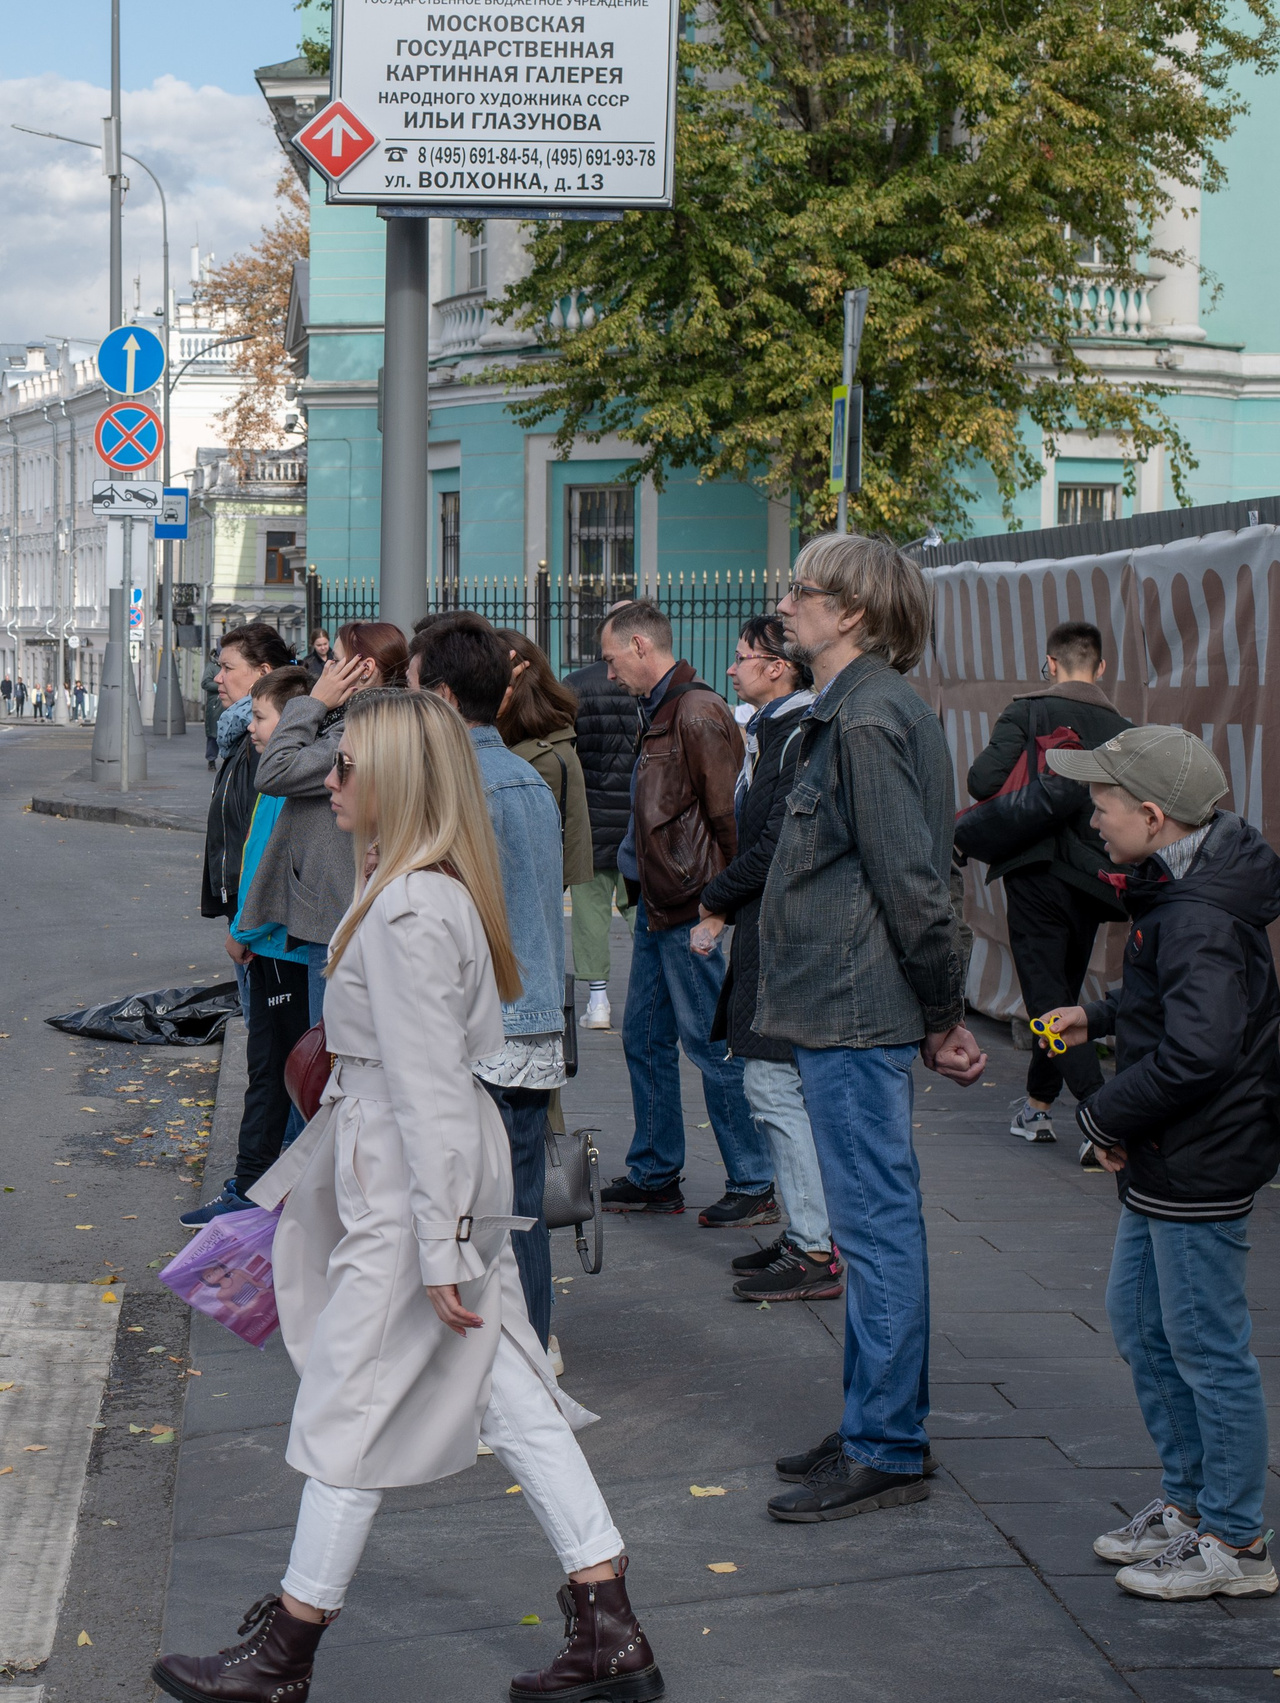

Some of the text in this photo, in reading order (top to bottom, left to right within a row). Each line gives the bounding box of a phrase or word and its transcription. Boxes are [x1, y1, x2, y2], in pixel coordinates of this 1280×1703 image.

[427, 14, 585, 33] МОСКОВСКАЯ
[396, 39, 614, 60] ГОСУДАРСТВЕННАЯ
[386, 64, 623, 84] КАРТИННАЯ ГАЛЕРЕЯ
[378, 91, 630, 108] НАРОДНОГО ХУДОЖНИКА СССР
[404, 111, 602, 131] ИЛЬИ ГЛАЗУНОВА
[418, 146, 656, 169] 8 (495) 691-84-54, (495) 691-93-78
[384, 171, 604, 193] ул. ВОЛХОНКА, д. 13
[268, 993, 291, 1006] HIFT
